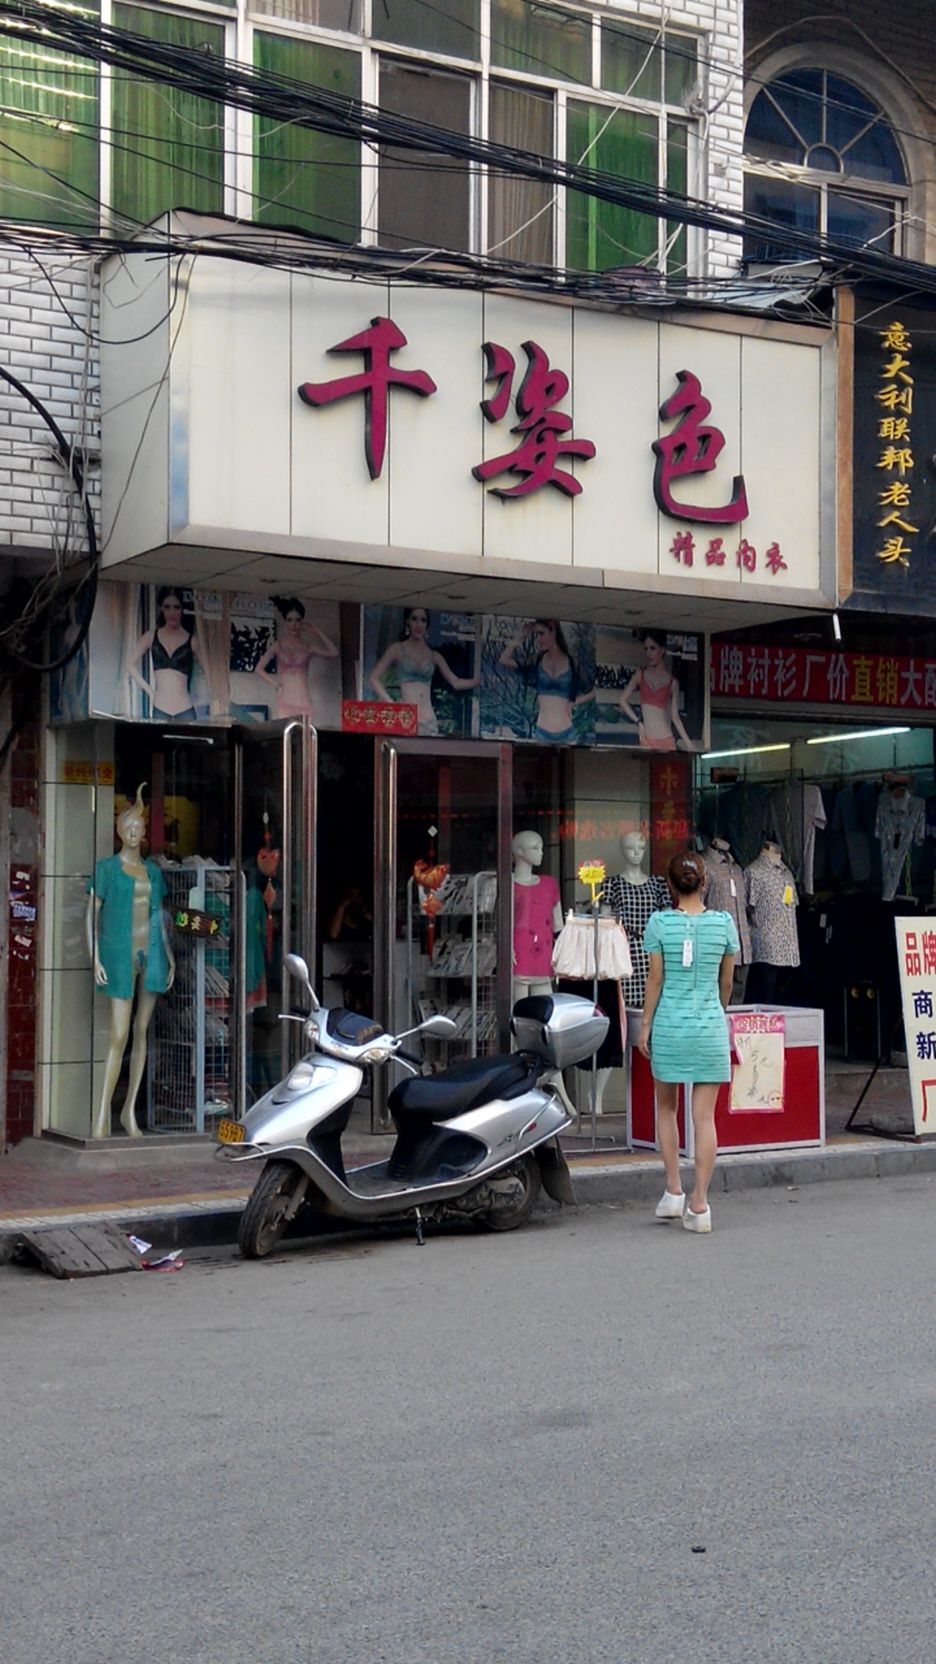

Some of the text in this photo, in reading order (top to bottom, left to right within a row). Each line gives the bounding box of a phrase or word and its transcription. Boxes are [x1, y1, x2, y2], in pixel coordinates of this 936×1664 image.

[297, 316, 749, 524] 千姿色
[876, 321, 919, 568] 意大利联邦老人头
[669, 531, 788, 575] 精品内衣
[711, 644, 936, 706] 牌衬衫厂价直销大
[912, 990, 933, 1019] 商
